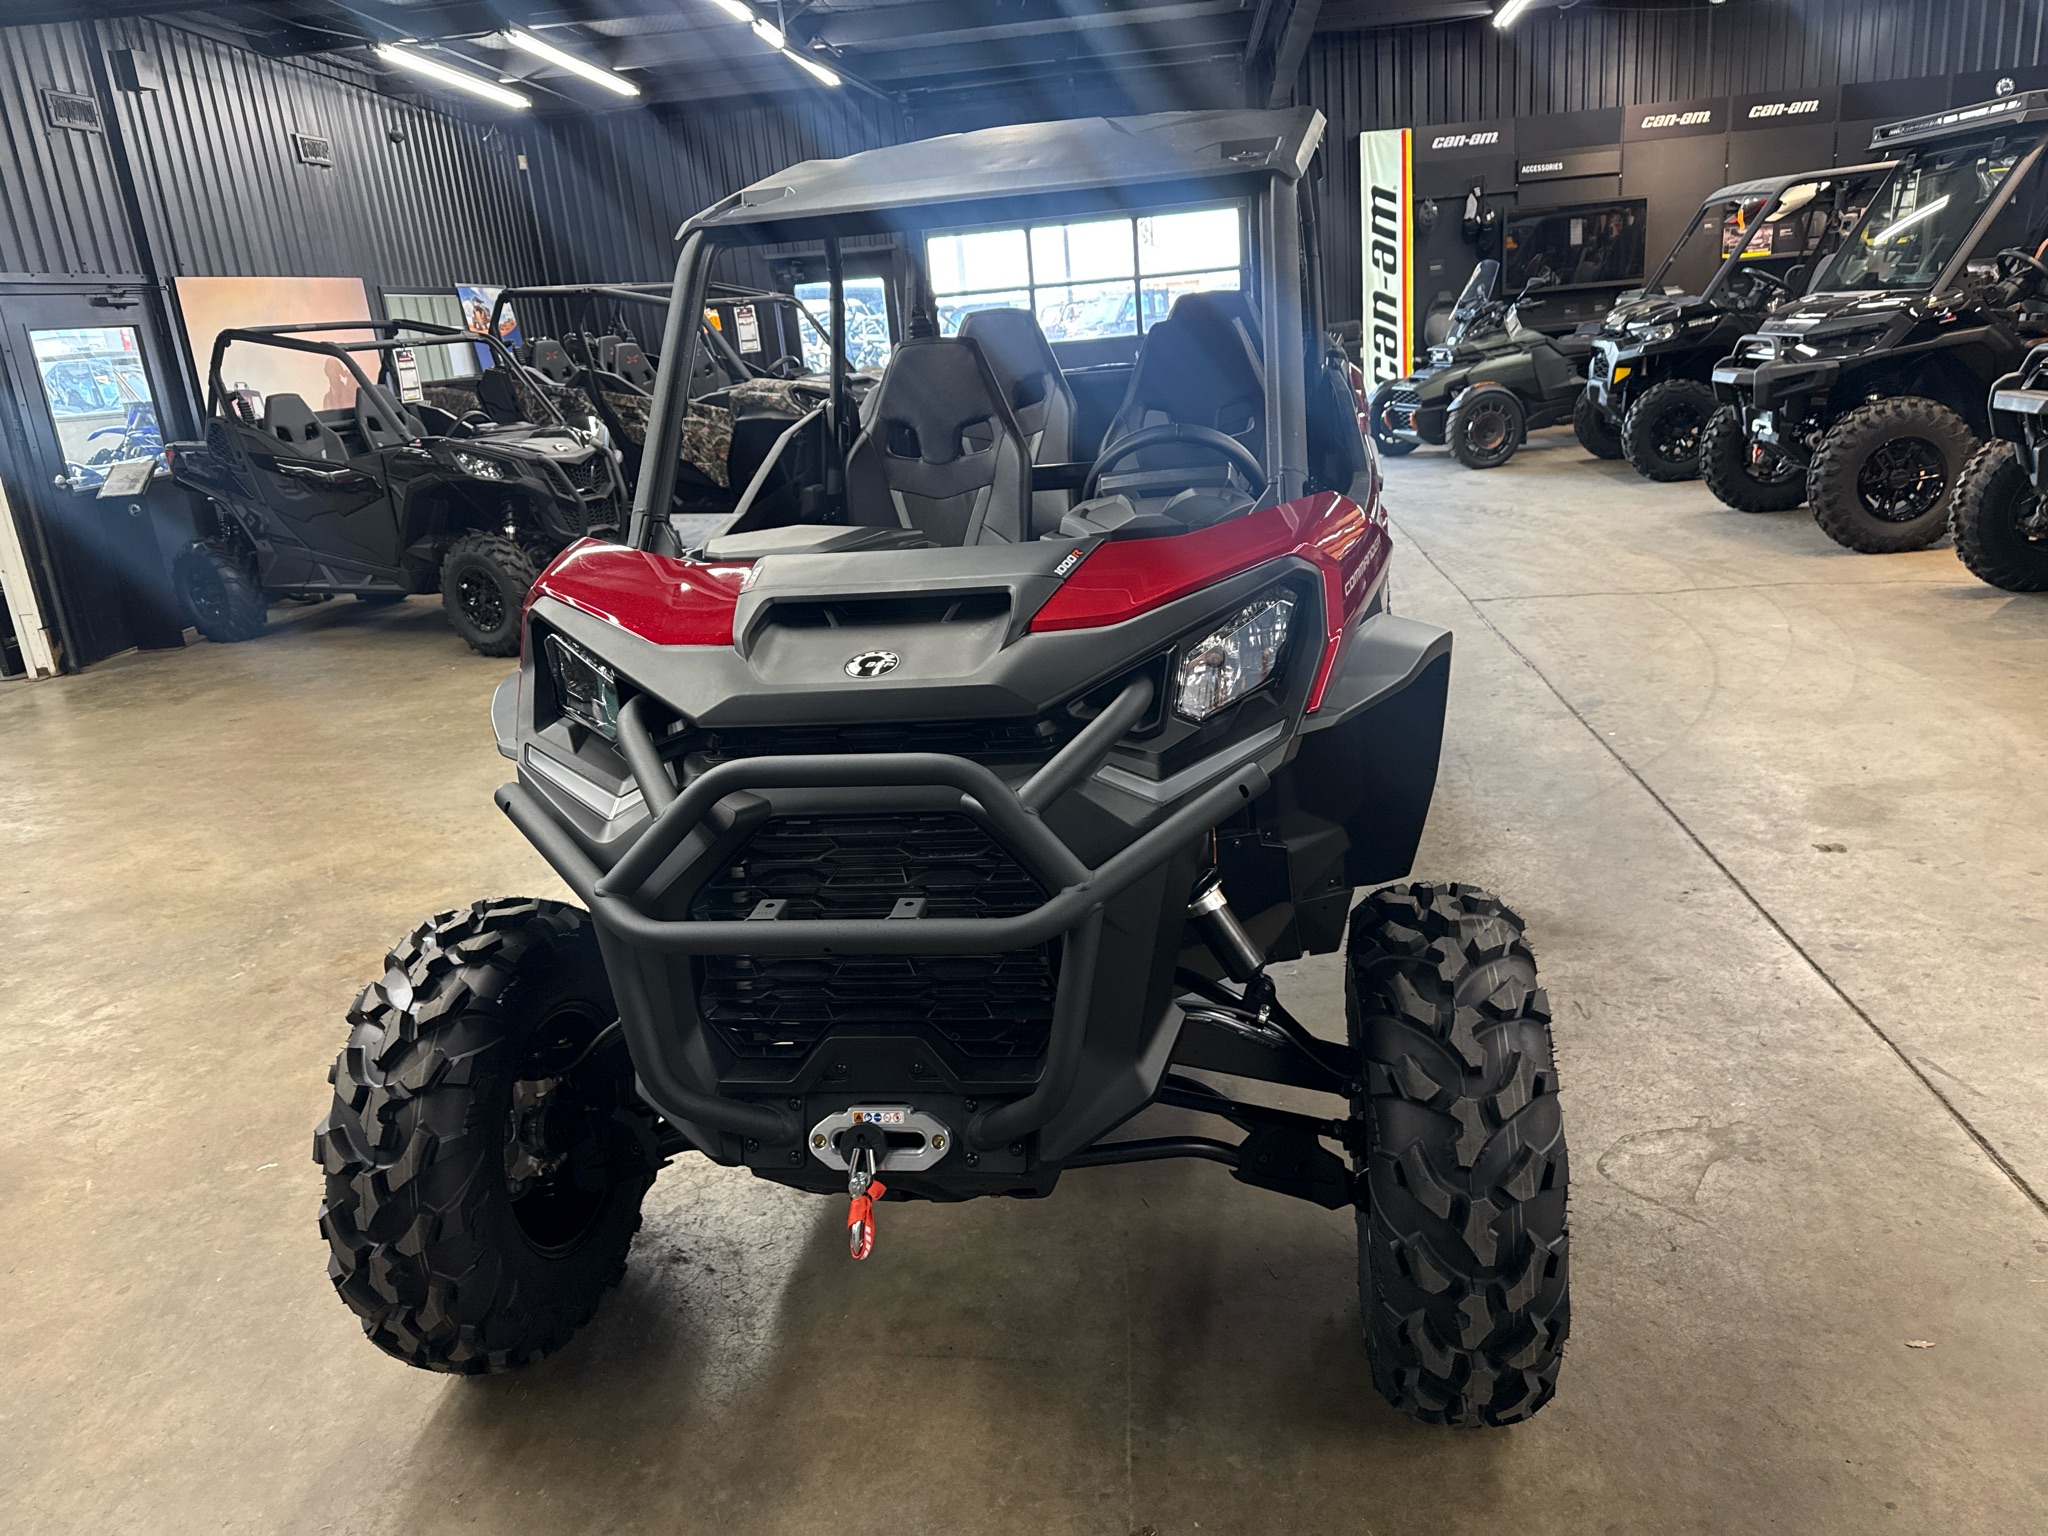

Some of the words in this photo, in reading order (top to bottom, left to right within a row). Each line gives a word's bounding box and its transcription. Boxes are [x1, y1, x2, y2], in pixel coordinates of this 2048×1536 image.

[1748, 100, 1820, 119] can-am
[1641, 110, 1711, 129] can-am
[1431, 131, 1499, 149] can-am
[1521, 162, 1563, 174] ACCESSORIES
[1371, 185, 1398, 386] can-am
[1053, 549, 1084, 576] 1000R
